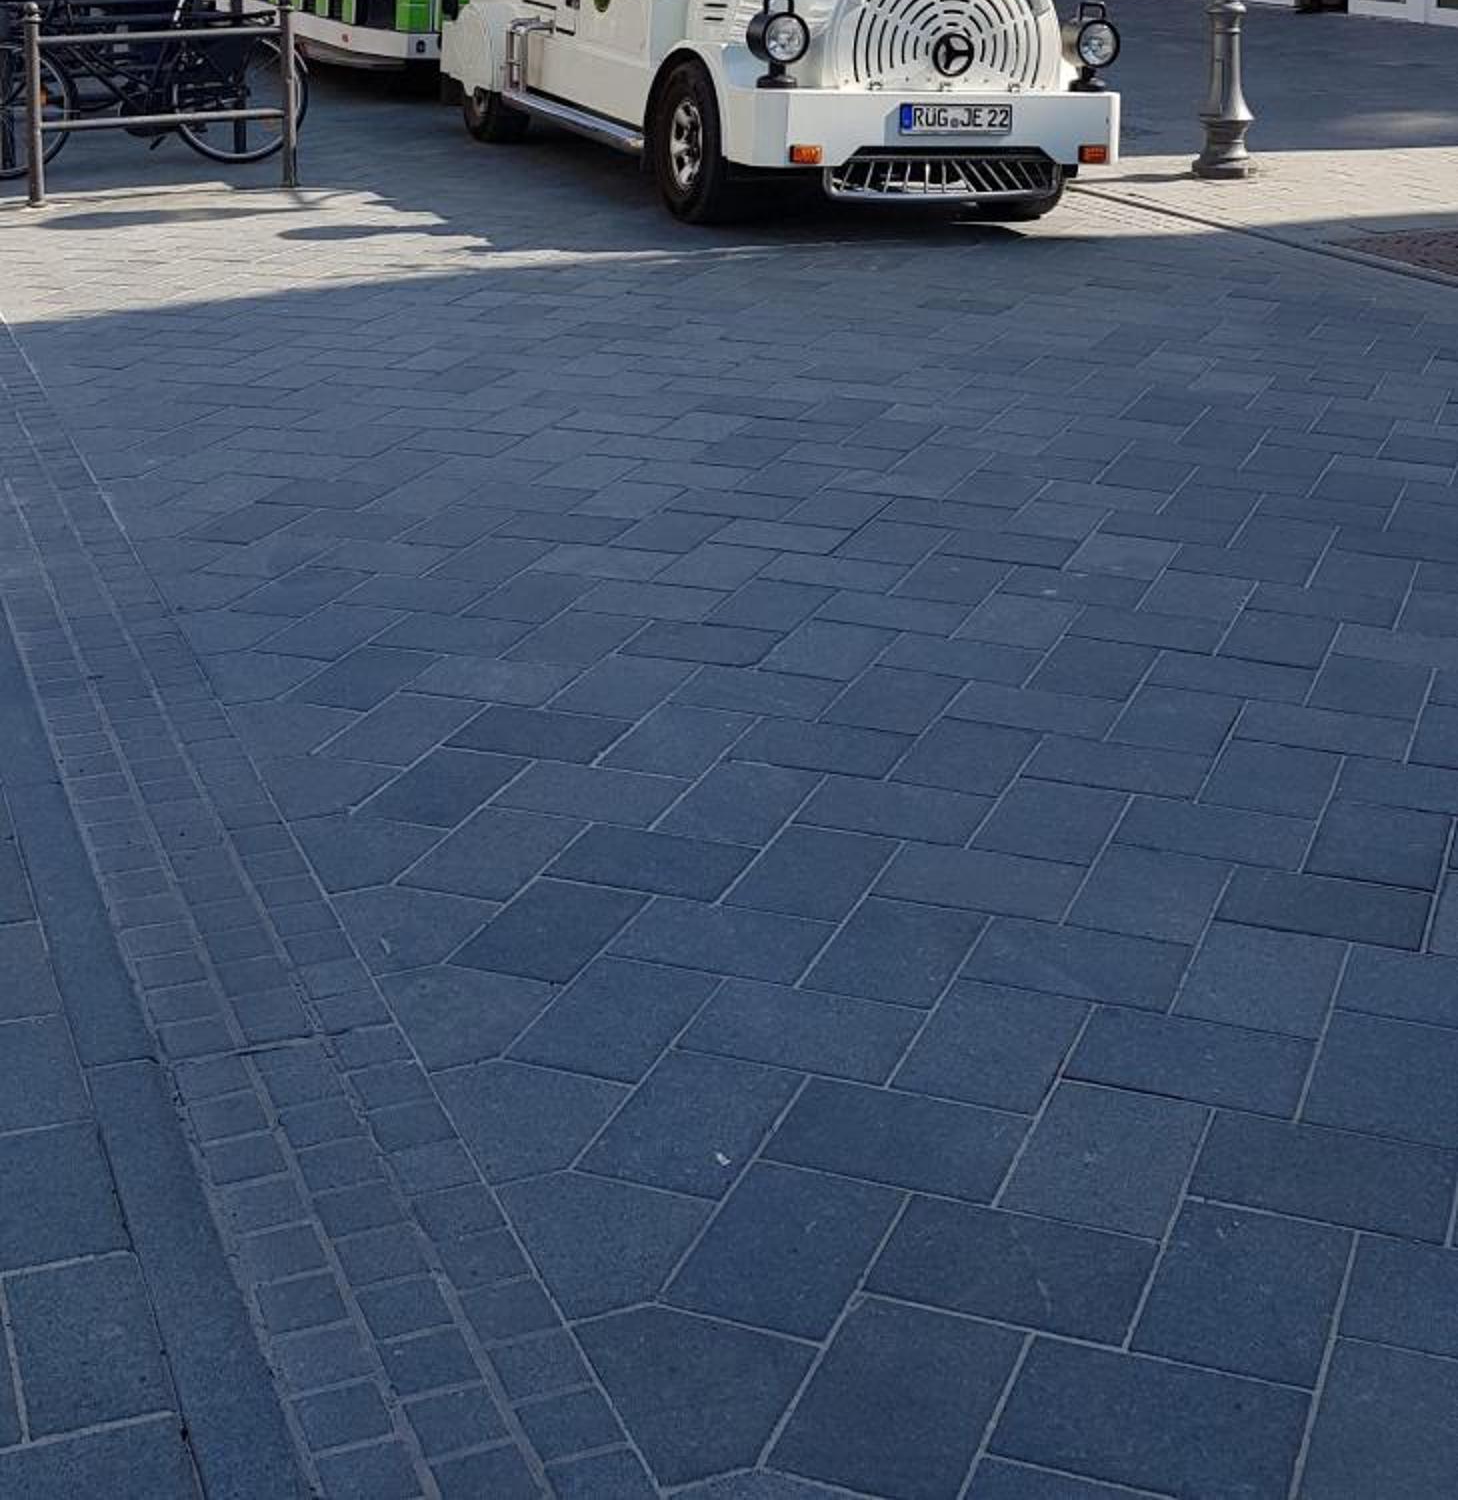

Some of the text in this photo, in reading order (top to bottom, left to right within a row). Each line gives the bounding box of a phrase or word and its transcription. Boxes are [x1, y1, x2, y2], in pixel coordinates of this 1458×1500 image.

[913, 107, 1009, 128] RÜG JE 22
